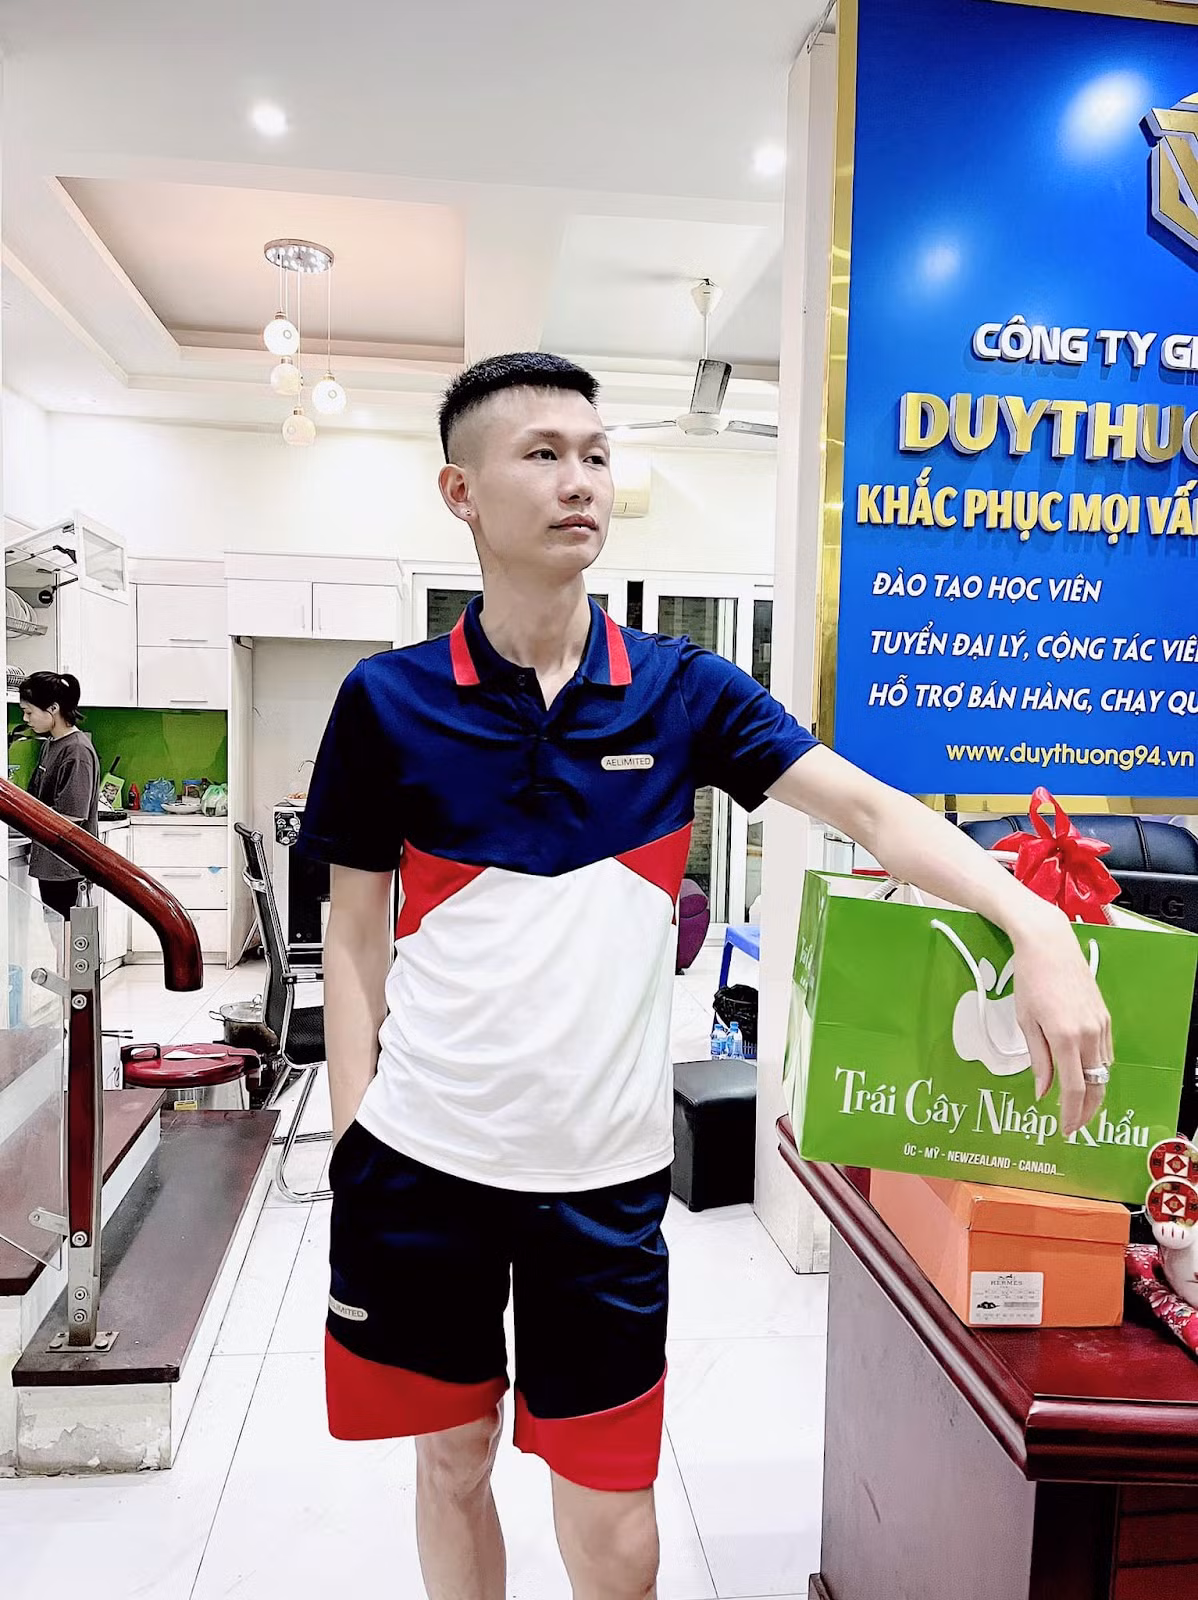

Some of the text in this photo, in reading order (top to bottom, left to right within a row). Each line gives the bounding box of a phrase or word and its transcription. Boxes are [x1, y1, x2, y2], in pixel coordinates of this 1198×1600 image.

[973, 314, 1090, 363] CÔNG
[1096, 329, 1157, 368] TY
[857, 466, 1198, 545] KHẮC PHỤC MỌI VẤ
[872, 567, 1103, 604] ĐÀO TẠO HỌC VIÊN
[871, 621, 1198, 663] TUYỂN ĐẠI LÝ, CỘNG TÁC VIÊ
[868, 674, 908, 707] HỖ
[915, 682, 965, 711] TRỢ
[967, 680, 1017, 709] BÁN
[1020, 681, 1093, 714] HÀNG,
[1100, 689, 1165, 716] CHẠY
[606, 757, 651, 767] AELIMITED
[946, 742, 1194, 771] www.duythuong94.vn
[834, 1066, 897, 1116] Trái
[905, 1077, 968, 1134] Cây
[971, 1088, 1058, 1146] Nhập
[903, 1143, 917, 1156] ÚC
[924, 1146, 940, 1160] MỸ
[947, 1150, 1011, 1169] NEWZEALAND
